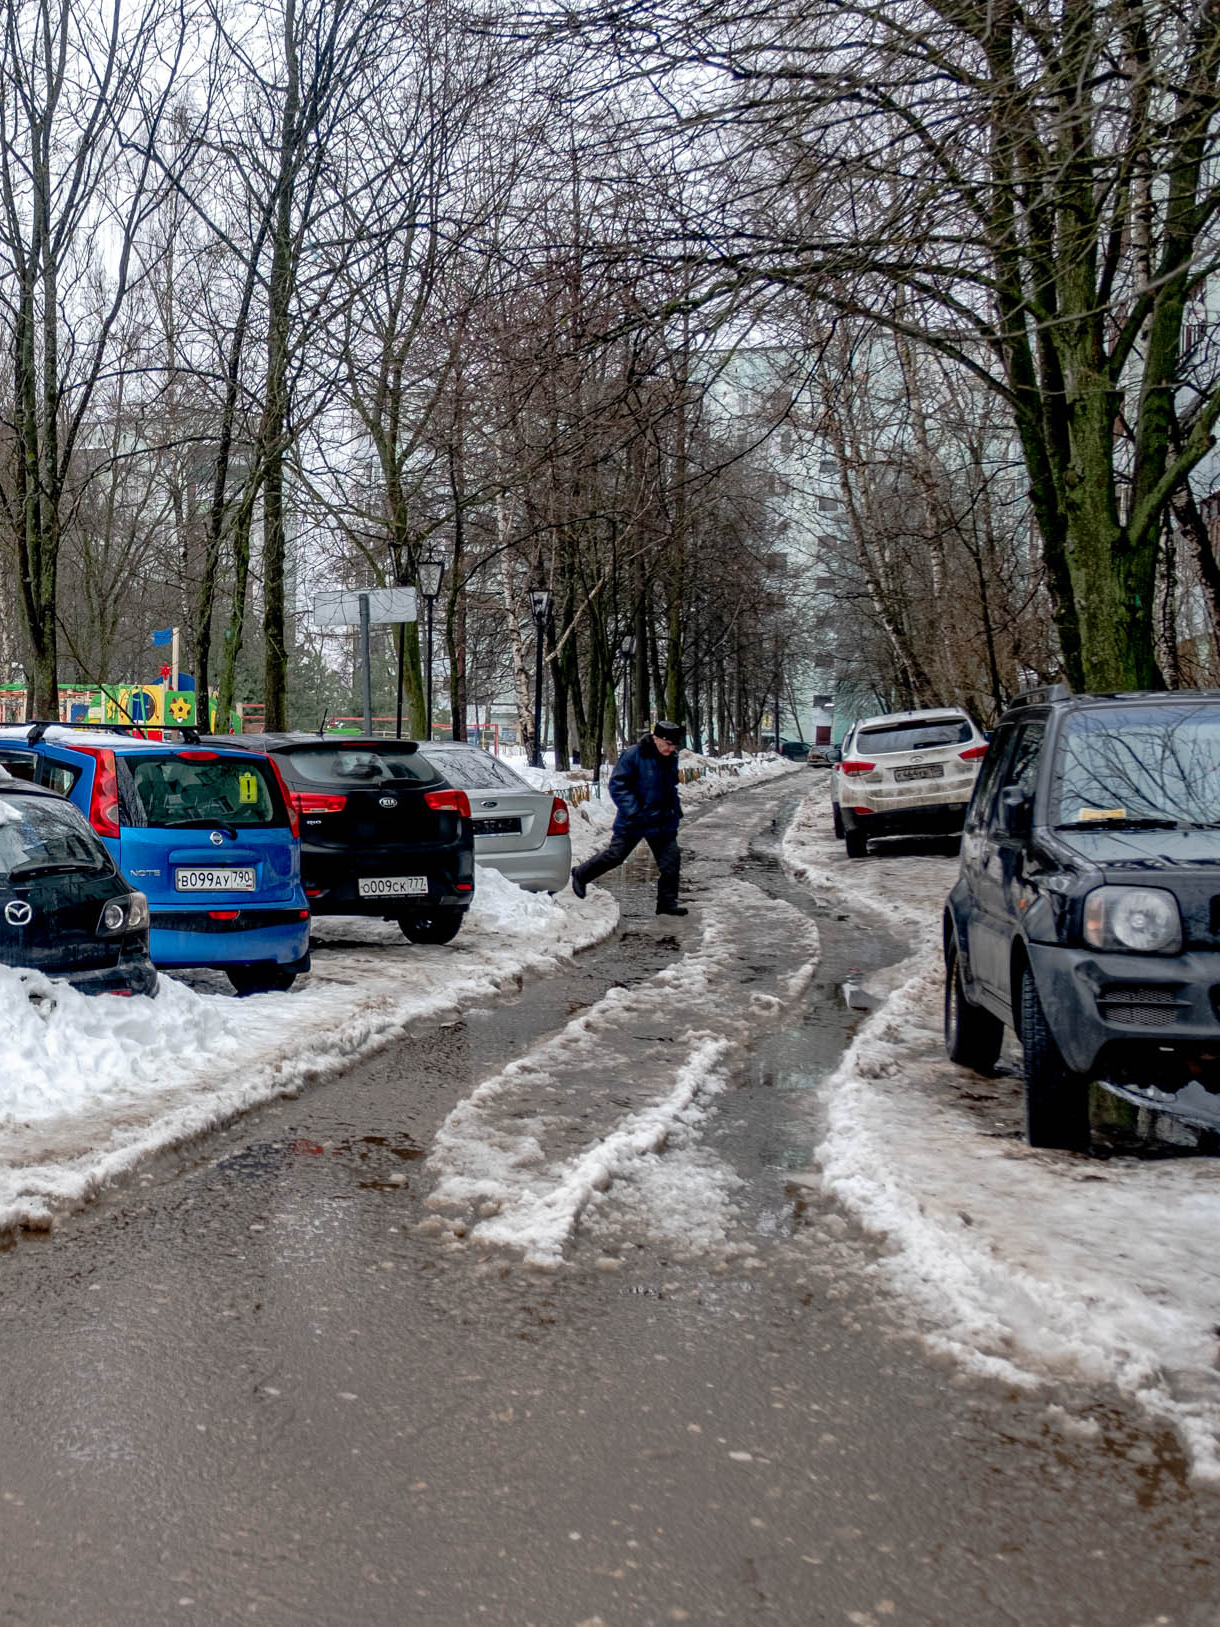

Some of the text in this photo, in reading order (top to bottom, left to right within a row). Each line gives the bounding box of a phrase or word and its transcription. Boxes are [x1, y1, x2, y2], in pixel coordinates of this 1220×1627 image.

[130, 869, 161, 877] NOTE
[233, 871, 250, 883] 790
[408, 878, 424, 888] 777
